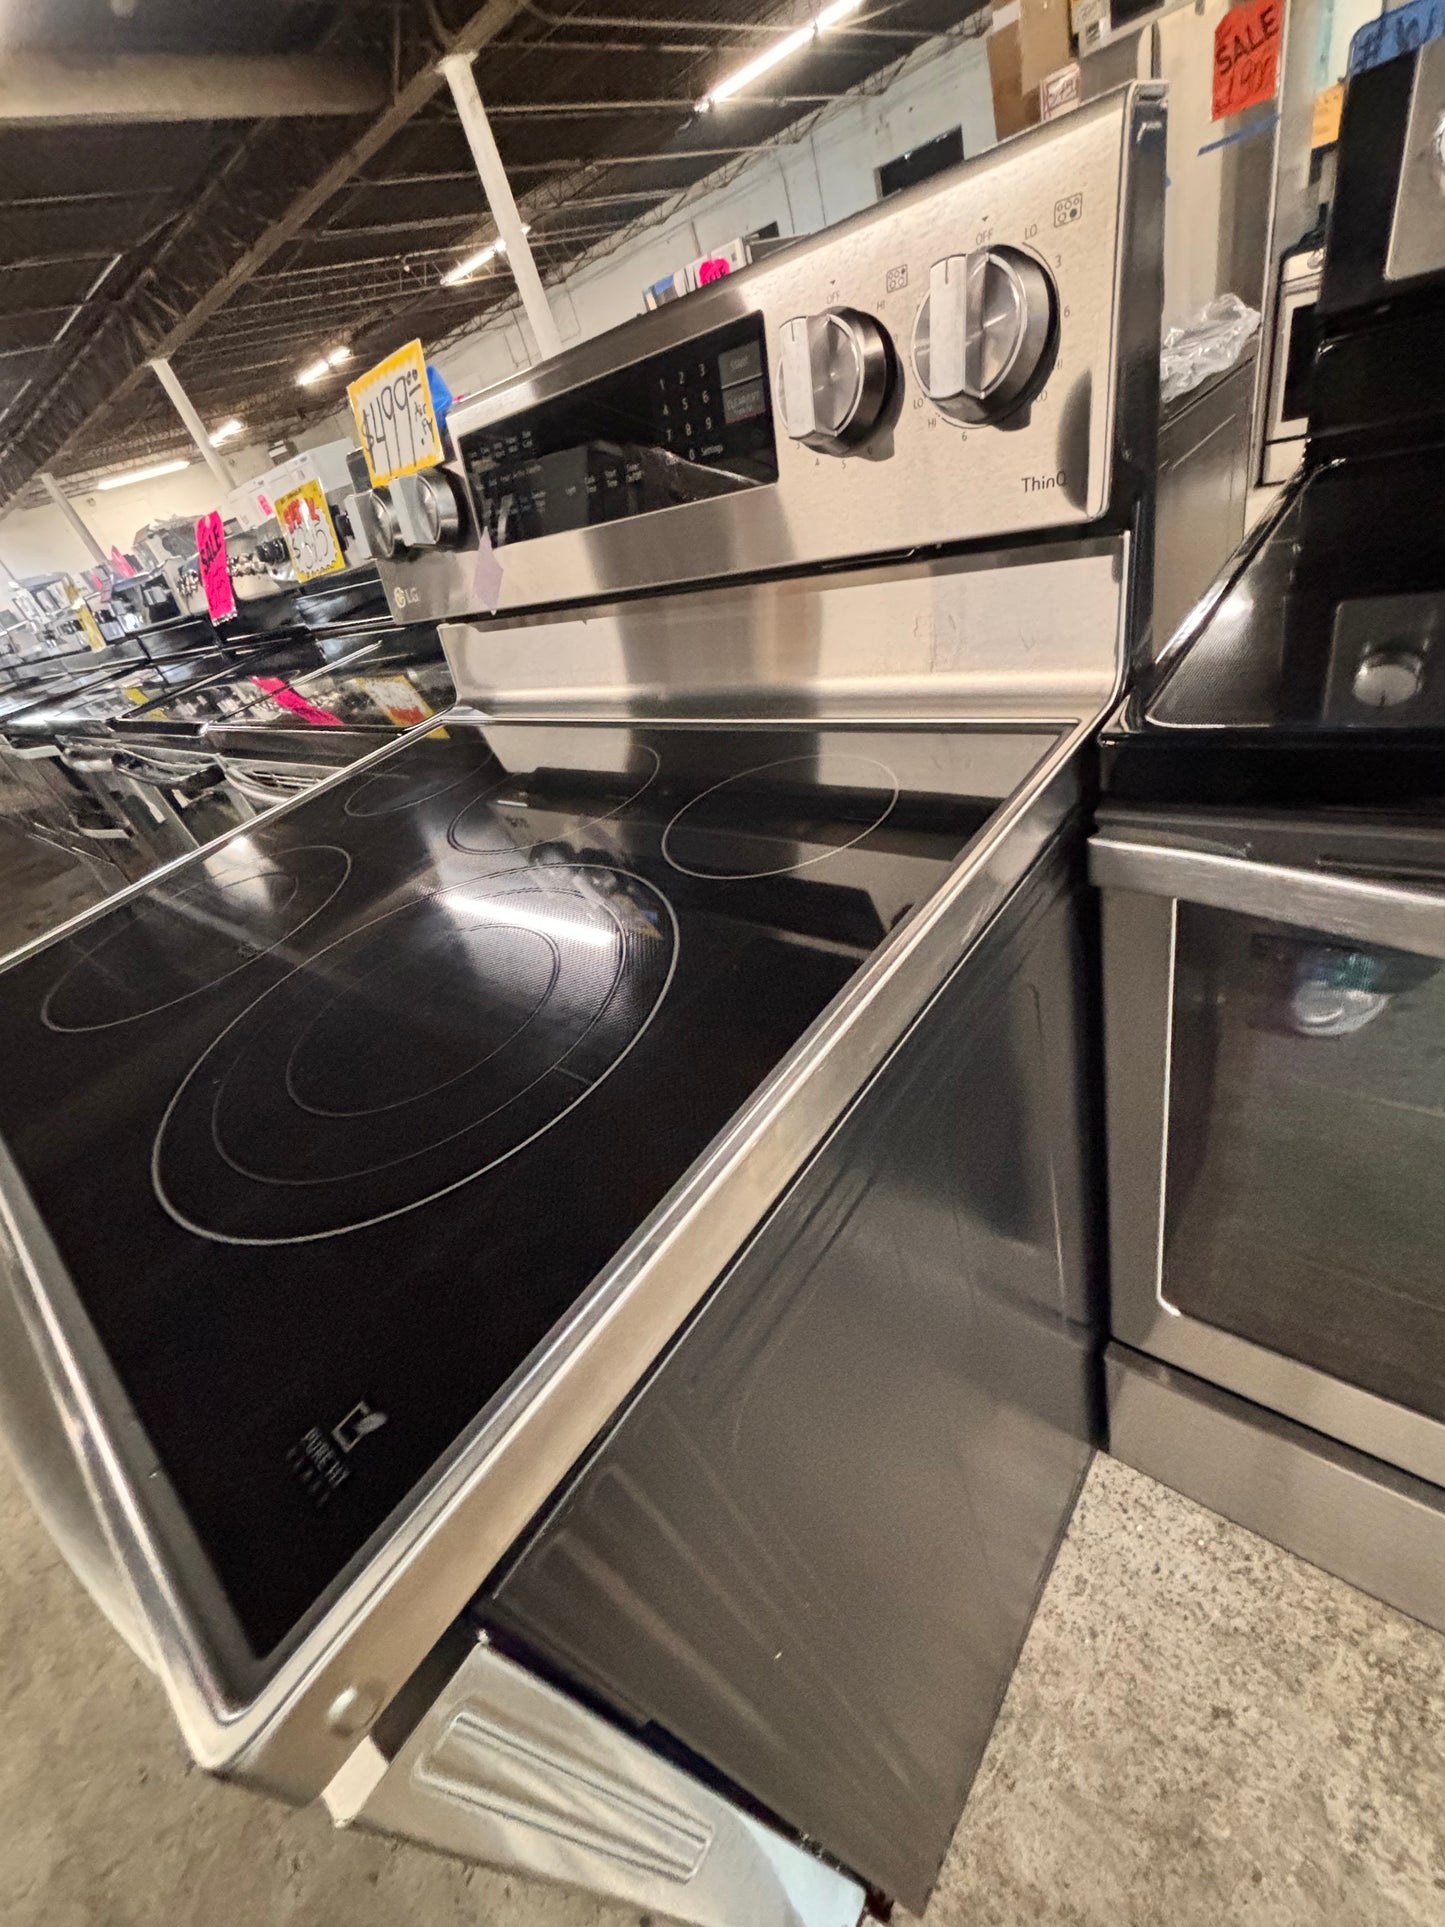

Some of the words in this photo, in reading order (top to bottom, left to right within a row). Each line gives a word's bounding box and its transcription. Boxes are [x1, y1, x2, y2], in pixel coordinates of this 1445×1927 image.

[1216, 5, 1279, 76] SALE
[975, 228, 994, 246] OFF
[1024, 224, 1038, 240] LO
[1055, 255, 1062, 269] 3
[1064, 309, 1071, 318] 6
[679, 371, 685, 385] 2
[699, 363, 706, 377] 3
[682, 397, 689, 411] 5
[702, 390, 710, 404] 6
[361, 375, 416, 477] $499
[685, 423, 692, 437] 8
[705, 416, 712, 430] 9
[1021, 470, 1069, 494] ThinQ
